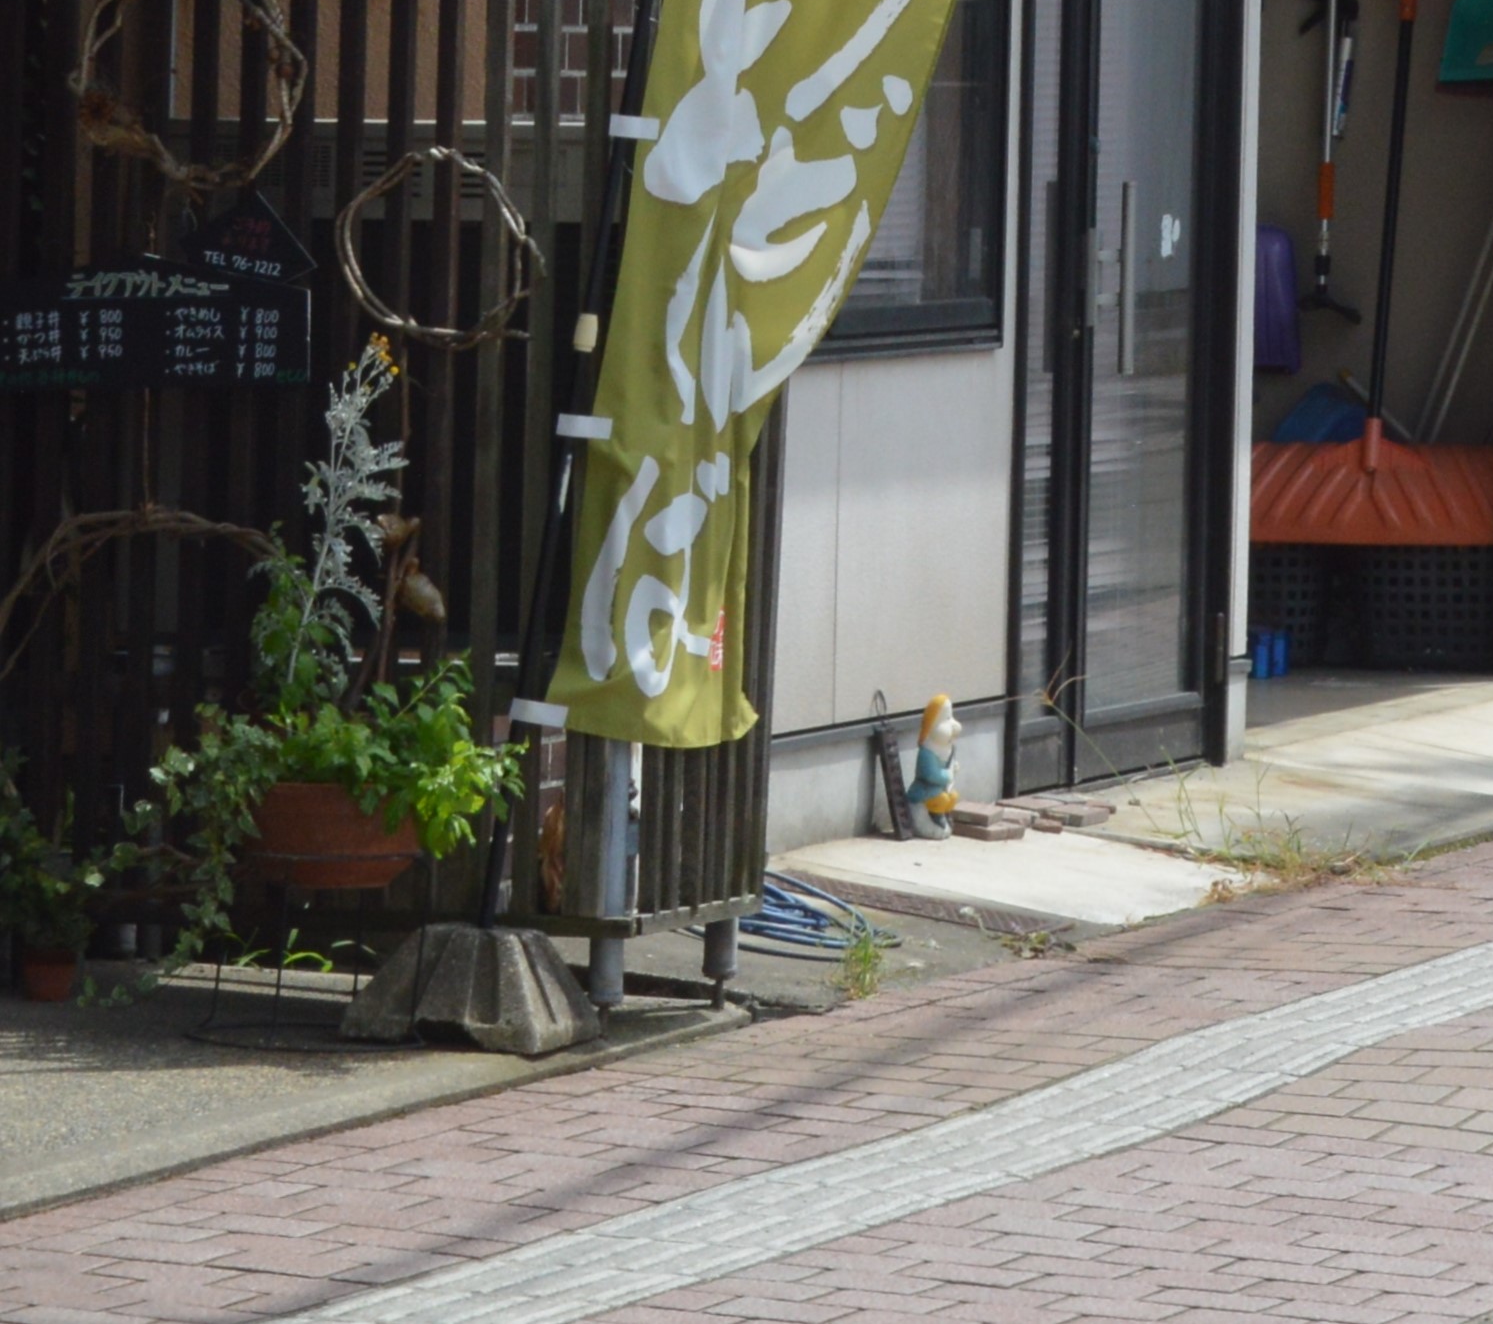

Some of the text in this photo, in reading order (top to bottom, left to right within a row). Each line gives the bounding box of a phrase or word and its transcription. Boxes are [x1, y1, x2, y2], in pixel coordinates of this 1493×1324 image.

[203, 251, 281, 277] TEL 76-1212
[66, 270, 230, 297] テイクアウトメニュー
[99, 310, 122, 325] 800
[254, 309, 279, 325] 800
[174, 324, 225, 340] オムライス
[253, 325, 278, 339] 900
[174, 345, 211, 358] カレー
[254, 344, 277, 359] 800
[253, 362, 275, 377] 800
